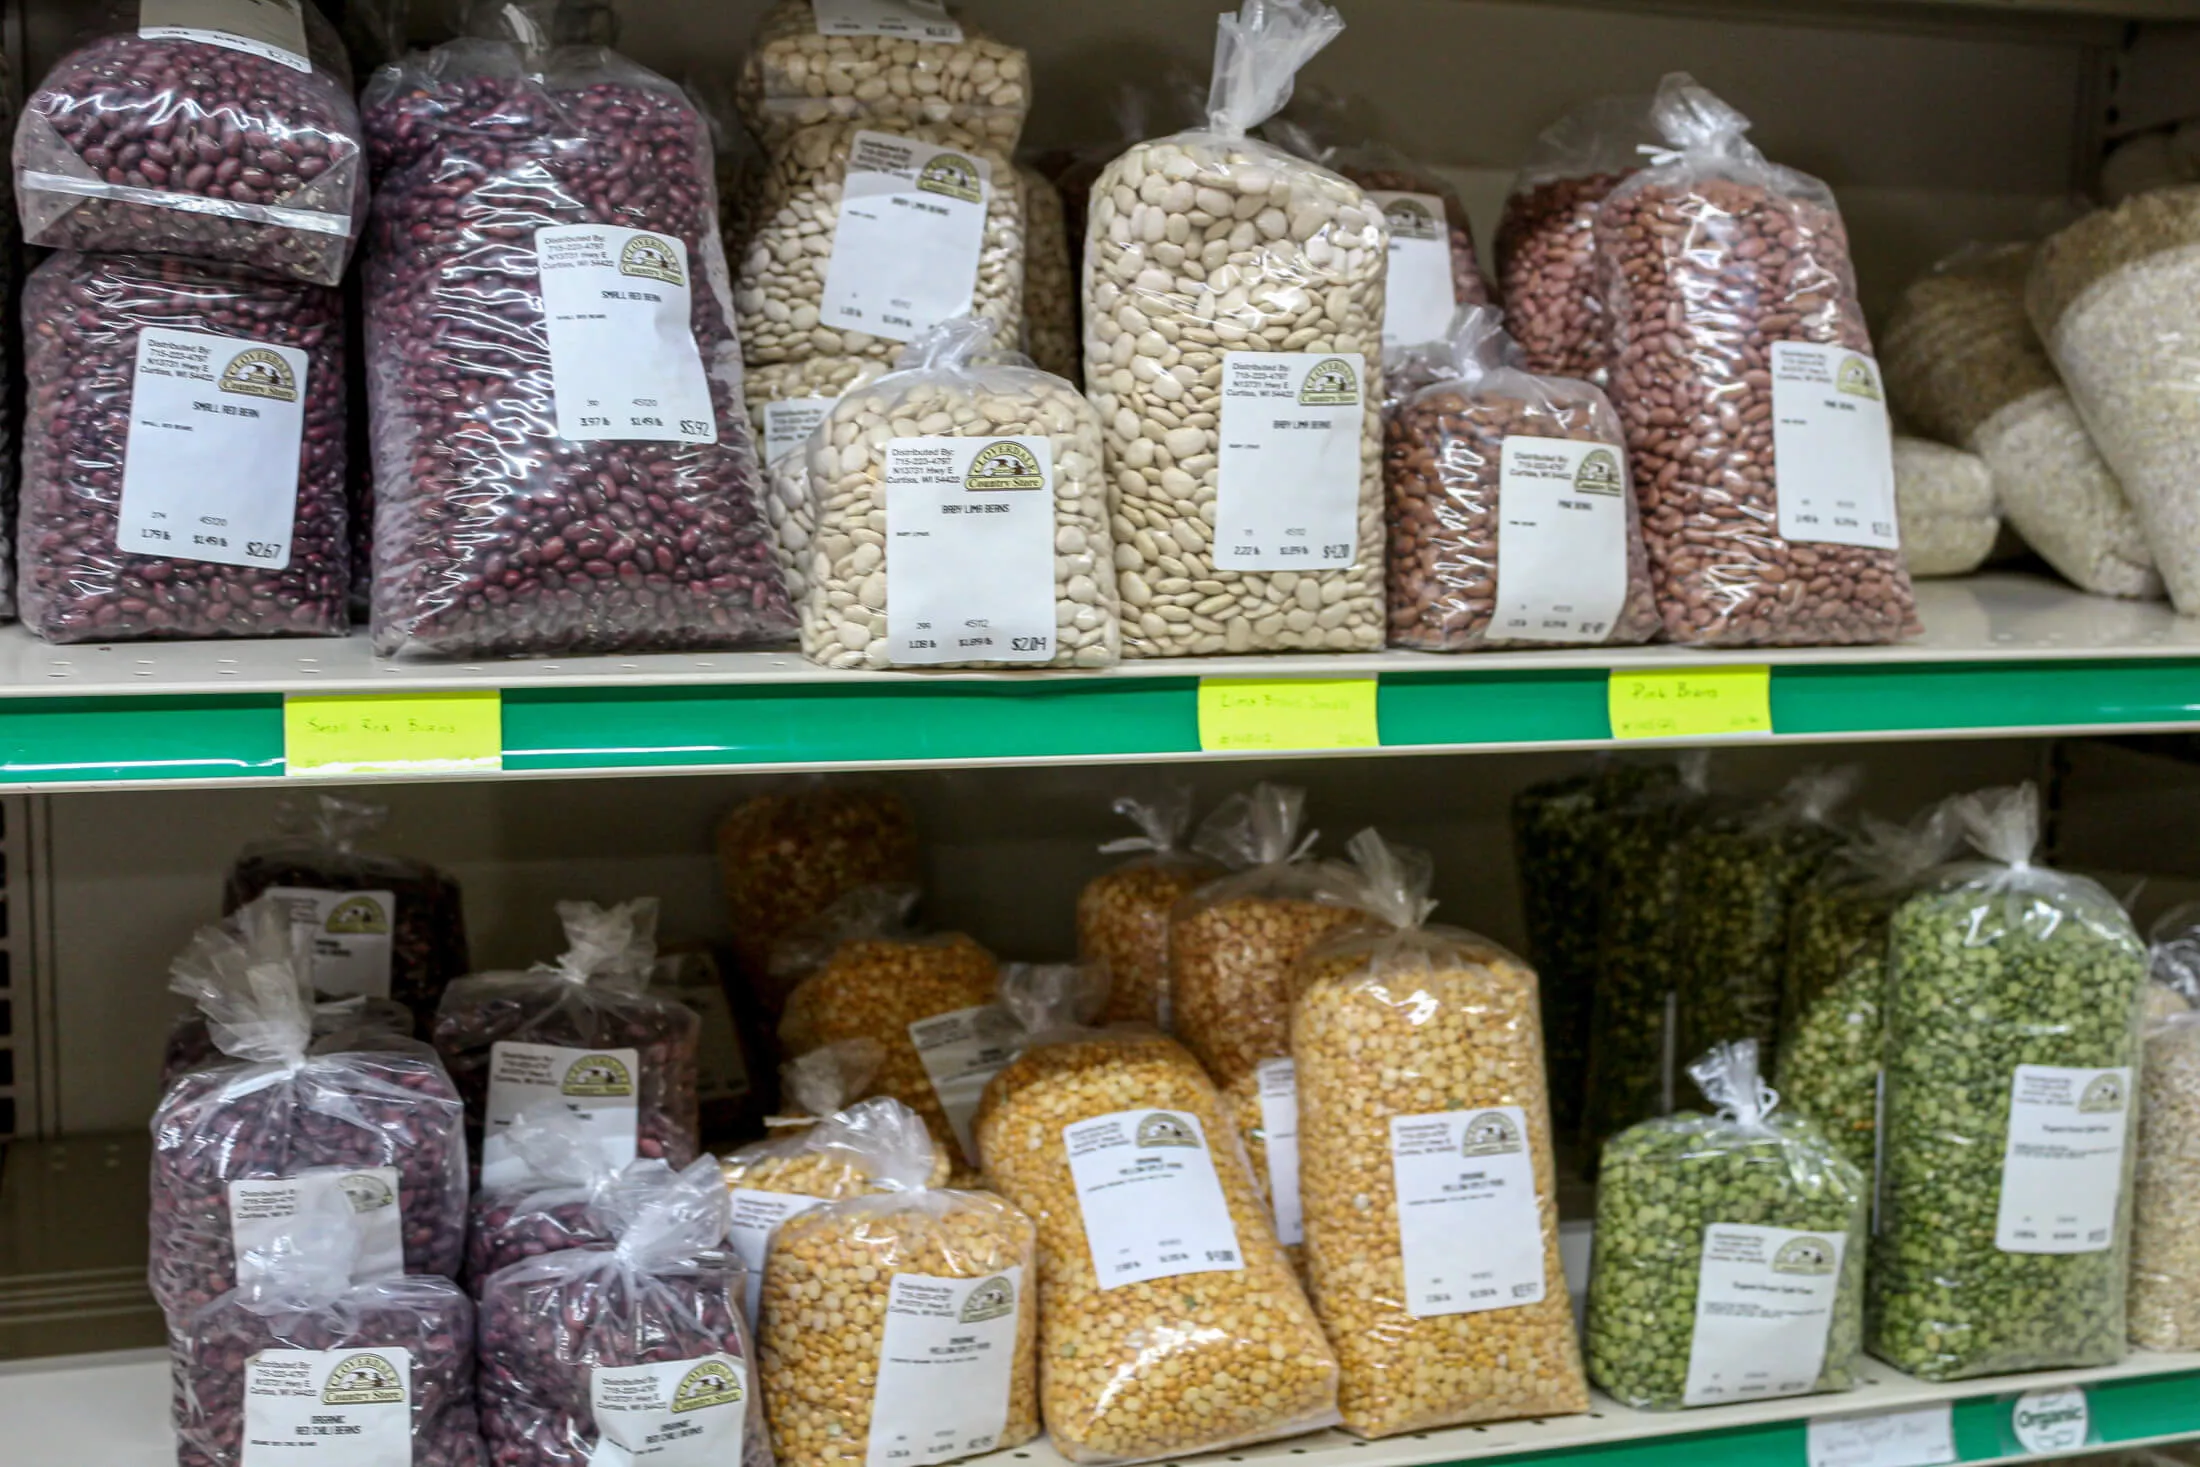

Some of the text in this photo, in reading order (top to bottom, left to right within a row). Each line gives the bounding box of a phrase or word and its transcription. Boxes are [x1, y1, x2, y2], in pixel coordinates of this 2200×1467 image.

[192, 401, 220, 413] SMALL
[223, 405, 237, 415] RED
[892, 448, 939, 456] Distributed
[969, 478, 1040, 488] Country Store
[942, 504, 1010, 514] BABY LIMA BEANS
[327, 1391, 400, 1402] Country Store
[2018, 1405, 2083, 1430] Organic
